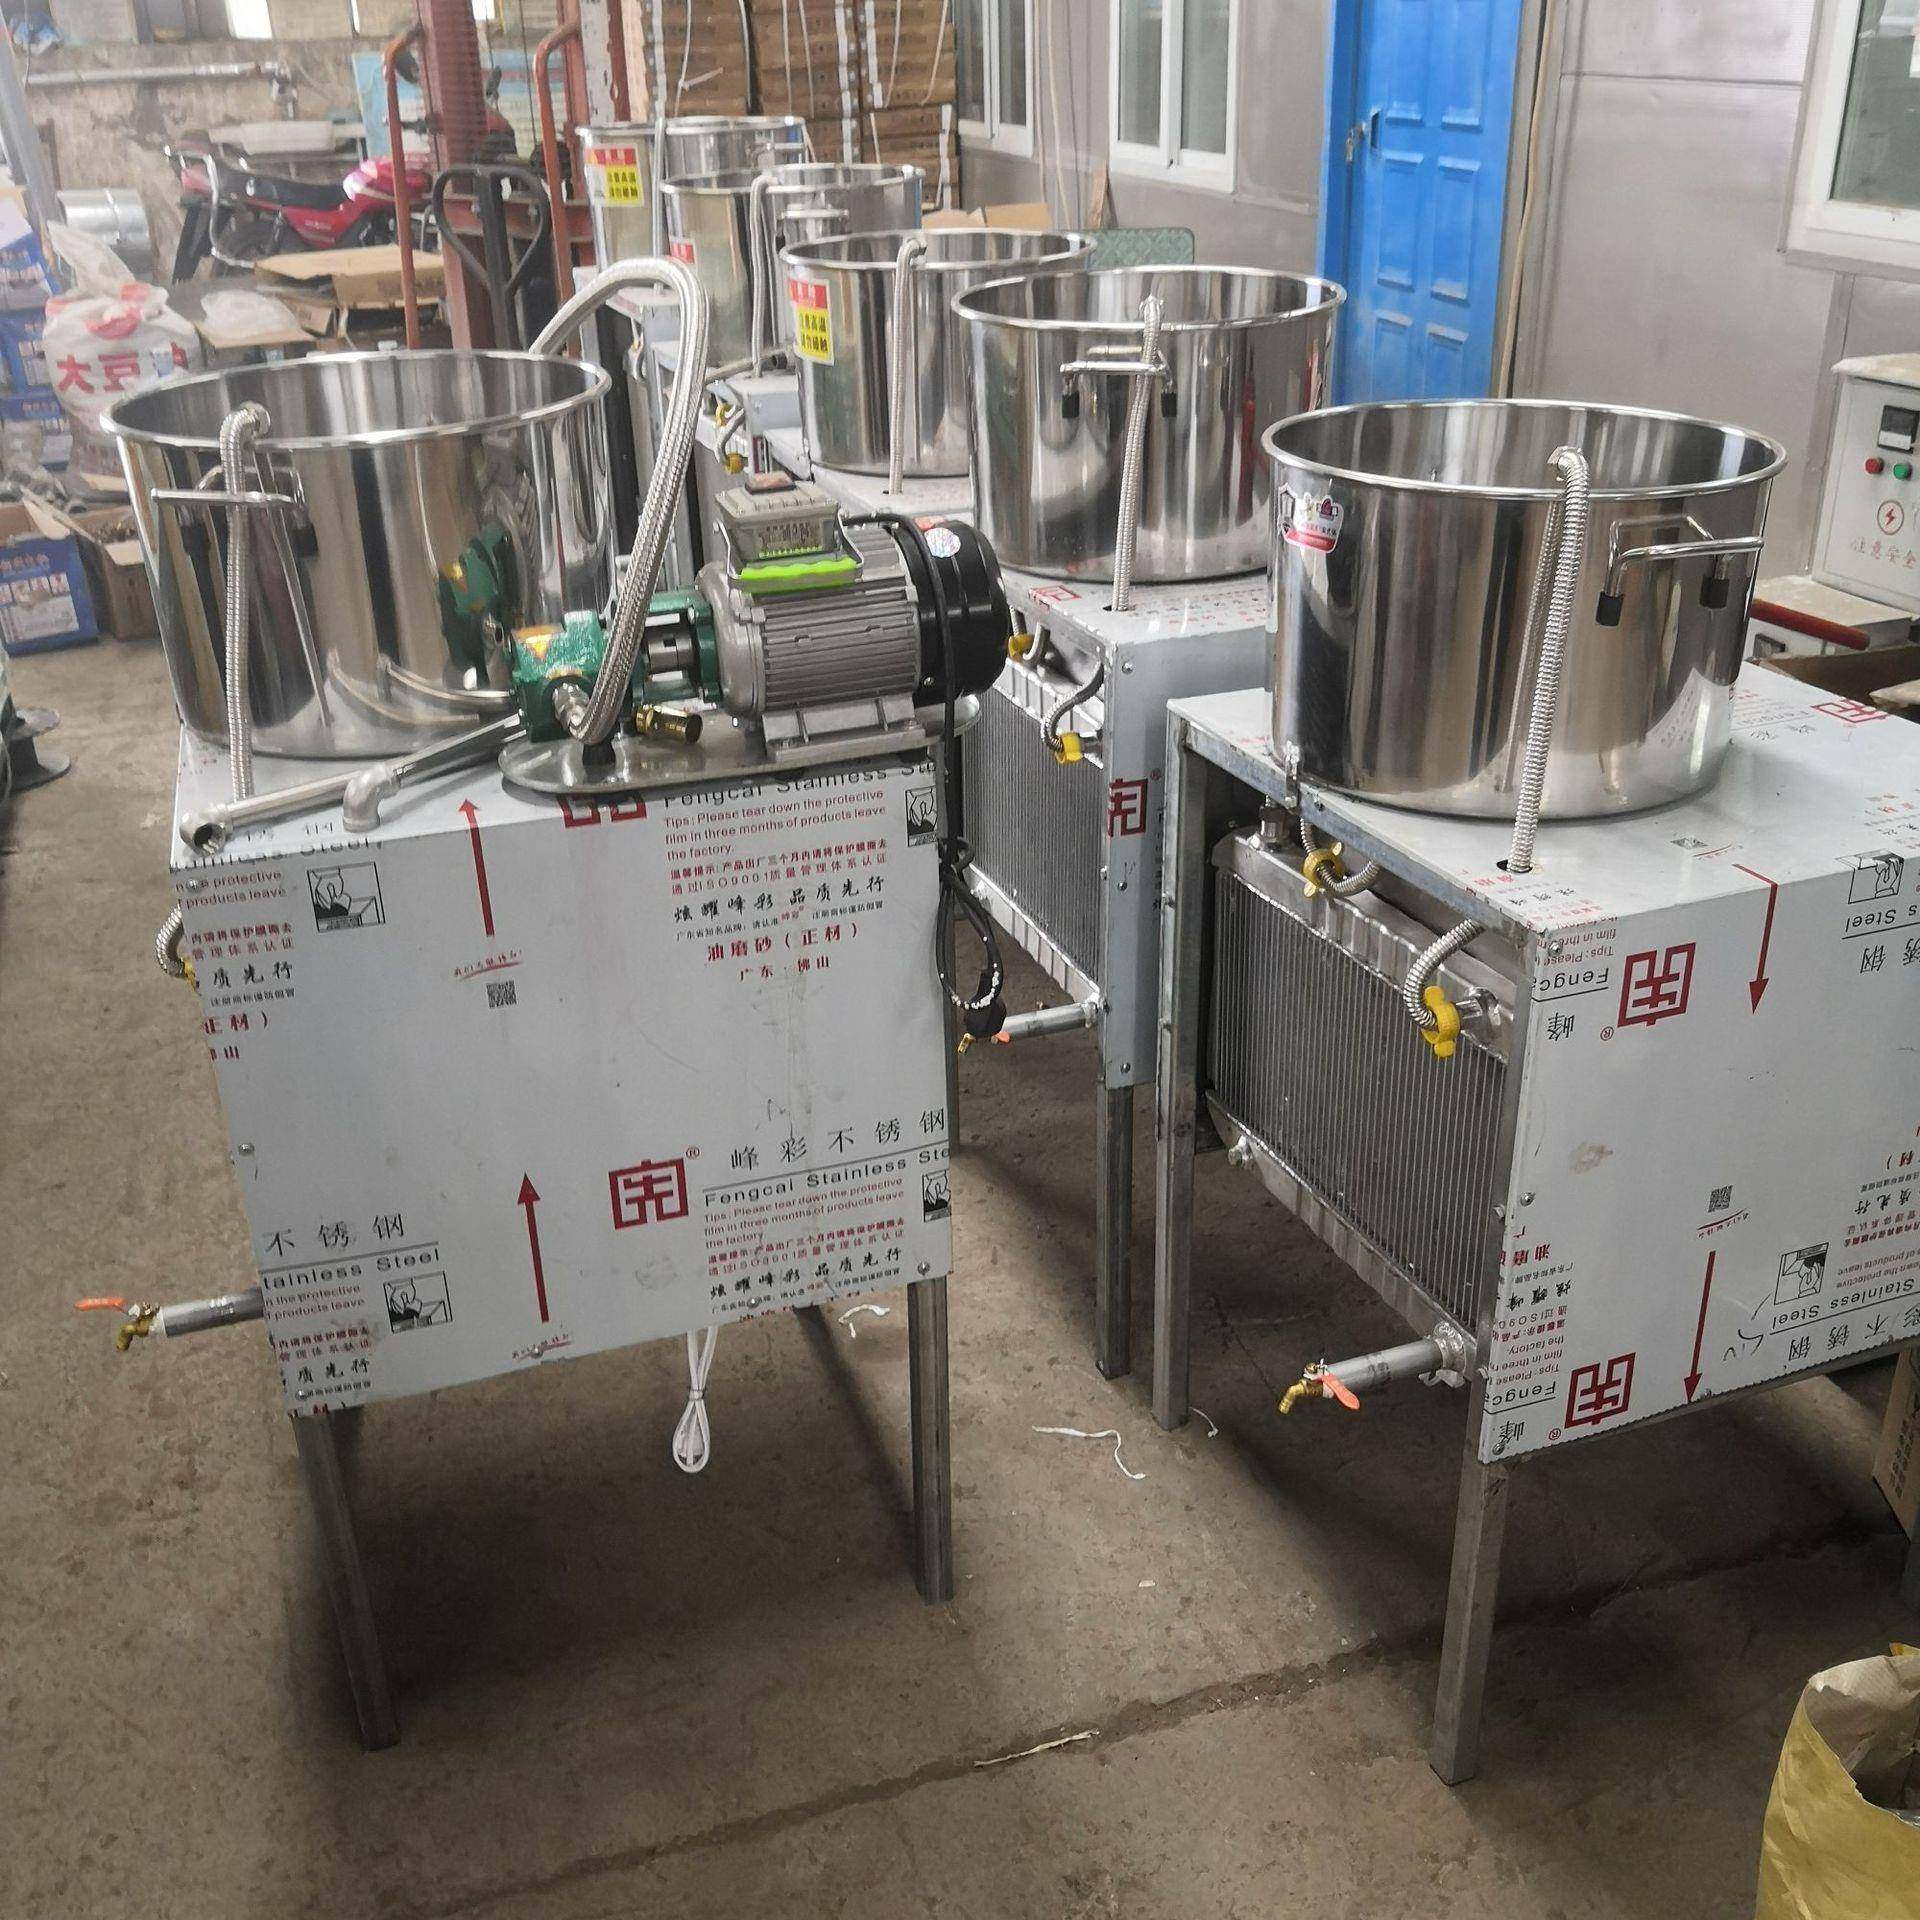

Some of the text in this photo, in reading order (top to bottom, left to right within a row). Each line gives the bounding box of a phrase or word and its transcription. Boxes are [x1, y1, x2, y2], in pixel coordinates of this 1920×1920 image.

[697, 810, 739, 825] Please
[742, 807, 767, 821] tear
[768, 802, 800, 816] down
[803, 798, 822, 810] the
[825, 789, 884, 806] protective
[665, 805, 886, 845] film in three months of products leave
[667, 848, 686, 862] the
[214, 871, 284, 890] protective
[186, 891, 247, 910] products
[249, 887, 287, 901] leave
[1845, 909, 1897, 933] Steel
[1547, 1012, 1575, 1041] 峰
[730, 1108, 945, 1171] 峰彩不锈钢
[806, 1157, 907, 1188] Stainless
[734, 1204, 772, 1219] Please
[774, 1200, 796, 1213] tear
[798, 1193, 828, 1208] down
[830, 1189, 847, 1200] the
[849, 1177, 903, 1196] protective
[704, 1224, 726, 1237] film
[740, 1216, 769, 1231] three
[771, 1209, 812, 1225] months
[826, 1197, 874, 1215] products
[875, 1190, 905, 1204] leave
[262, 1213, 405, 1257] 不锈钢
[706, 1237, 722, 1249] the
[263, 1248, 439, 1290] tainless Steel
[1837, 1264, 1863, 1276] leave
[1864, 1251, 1905, 1268] products
[1836, 1271, 1882, 1289] protective
[1884, 1267, 1899, 1278] the
[275, 1293, 296, 1305] the
[297, 1284, 361, 1301] protective
[1772, 1279, 1915, 1330] Stainless Steel
[274, 1302, 328, 1321] products
[1494, 1304, 1567, 1332] 通过ISO90
[1548, 1335, 1564, 1346] the
[1502, 1357, 1530, 1371] three
[1544, 1350, 1563, 1361] film
[1496, 1370, 1532, 1386] Please
